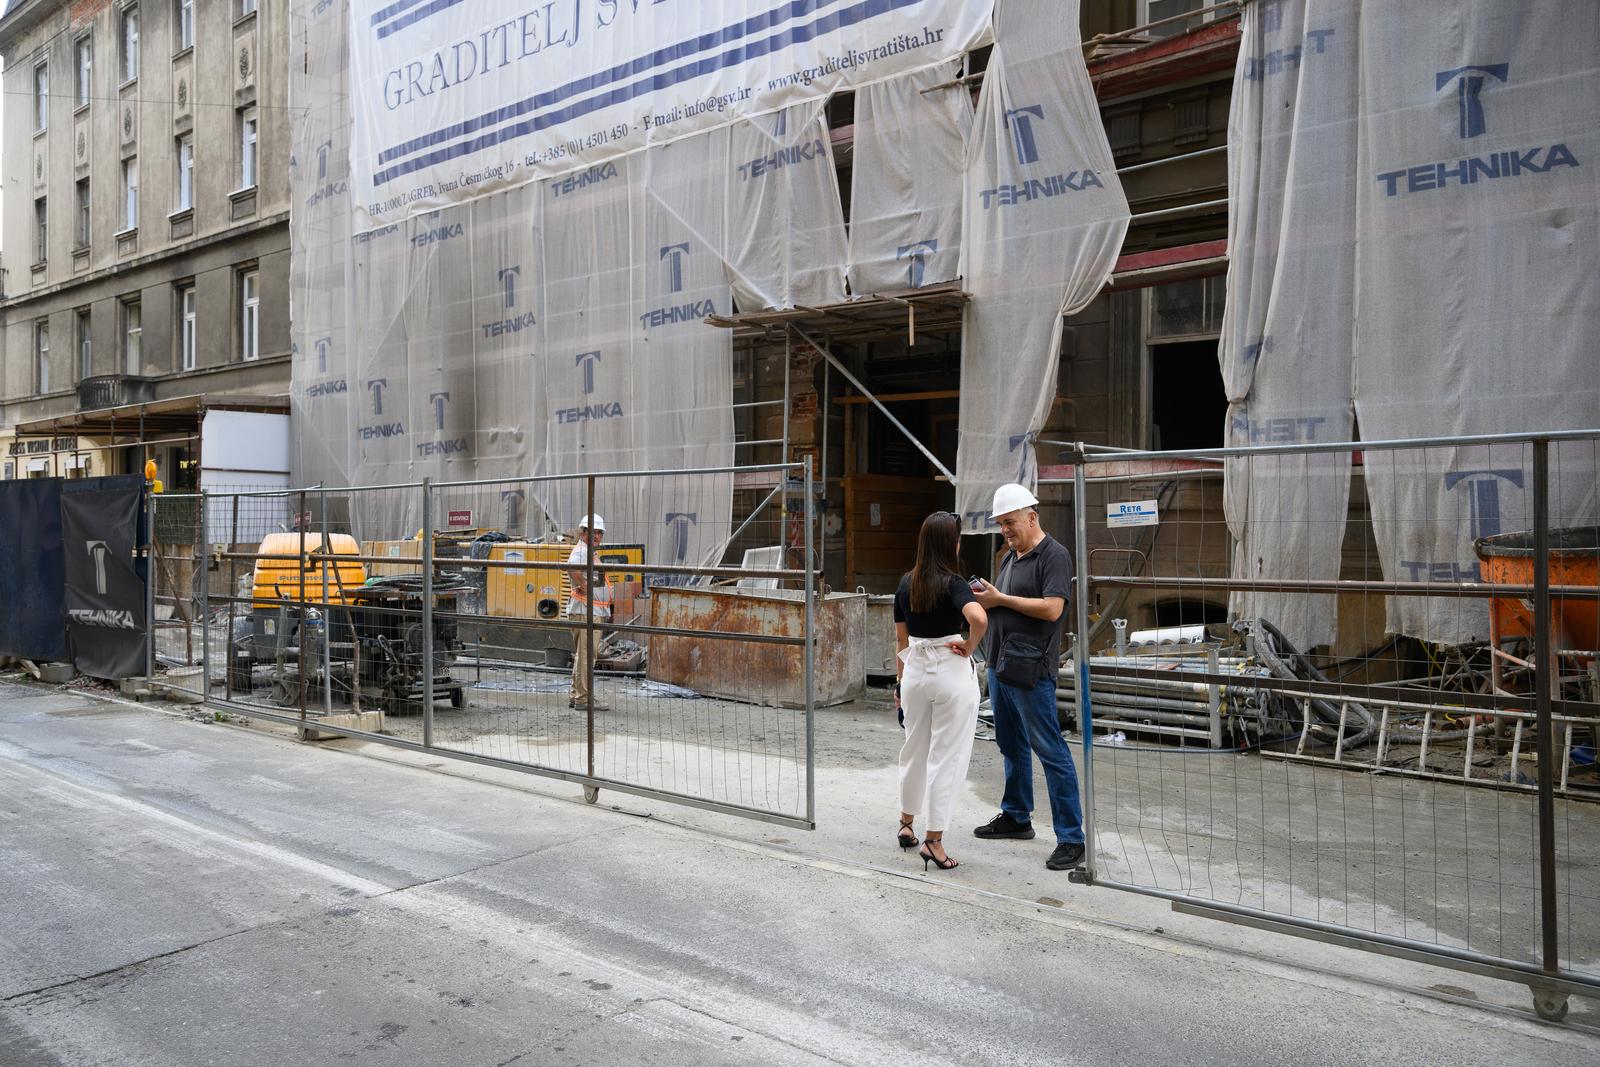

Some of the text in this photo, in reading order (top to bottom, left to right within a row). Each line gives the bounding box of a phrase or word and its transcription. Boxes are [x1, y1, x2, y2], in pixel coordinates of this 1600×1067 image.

[384, 0, 580, 110] GRADITELJ
[438, 180, 459, 194] Ivana
[505, 160, 514, 173] 16
[586, 130, 608, 148] 4501
[610, 123, 628, 140] 450
[684, 86, 751, 118] info@gsv.hr
[768, 26, 944, 91] www.graditeljsvratišta.hr
[738, 139, 826, 181] TEHNIKA
[1377, 143, 1579, 196] TEHNIKA
[552, 161, 617, 197] TEHNIKA
[979, 169, 1104, 209] TEHNIKA
[411, 223, 463, 249] TEHNIKA
[482, 312, 536, 338] TEHNIKA
[640, 299, 716, 330] TEHNIKA
[306, 380, 347, 397] TEHNIKA
[556, 402, 623, 424] TEHNIKA
[358, 422, 404, 440] TEHNIKA
[417, 438, 468, 456] TEHNIKA
[69, 609, 135, 629] TEHNIKA
